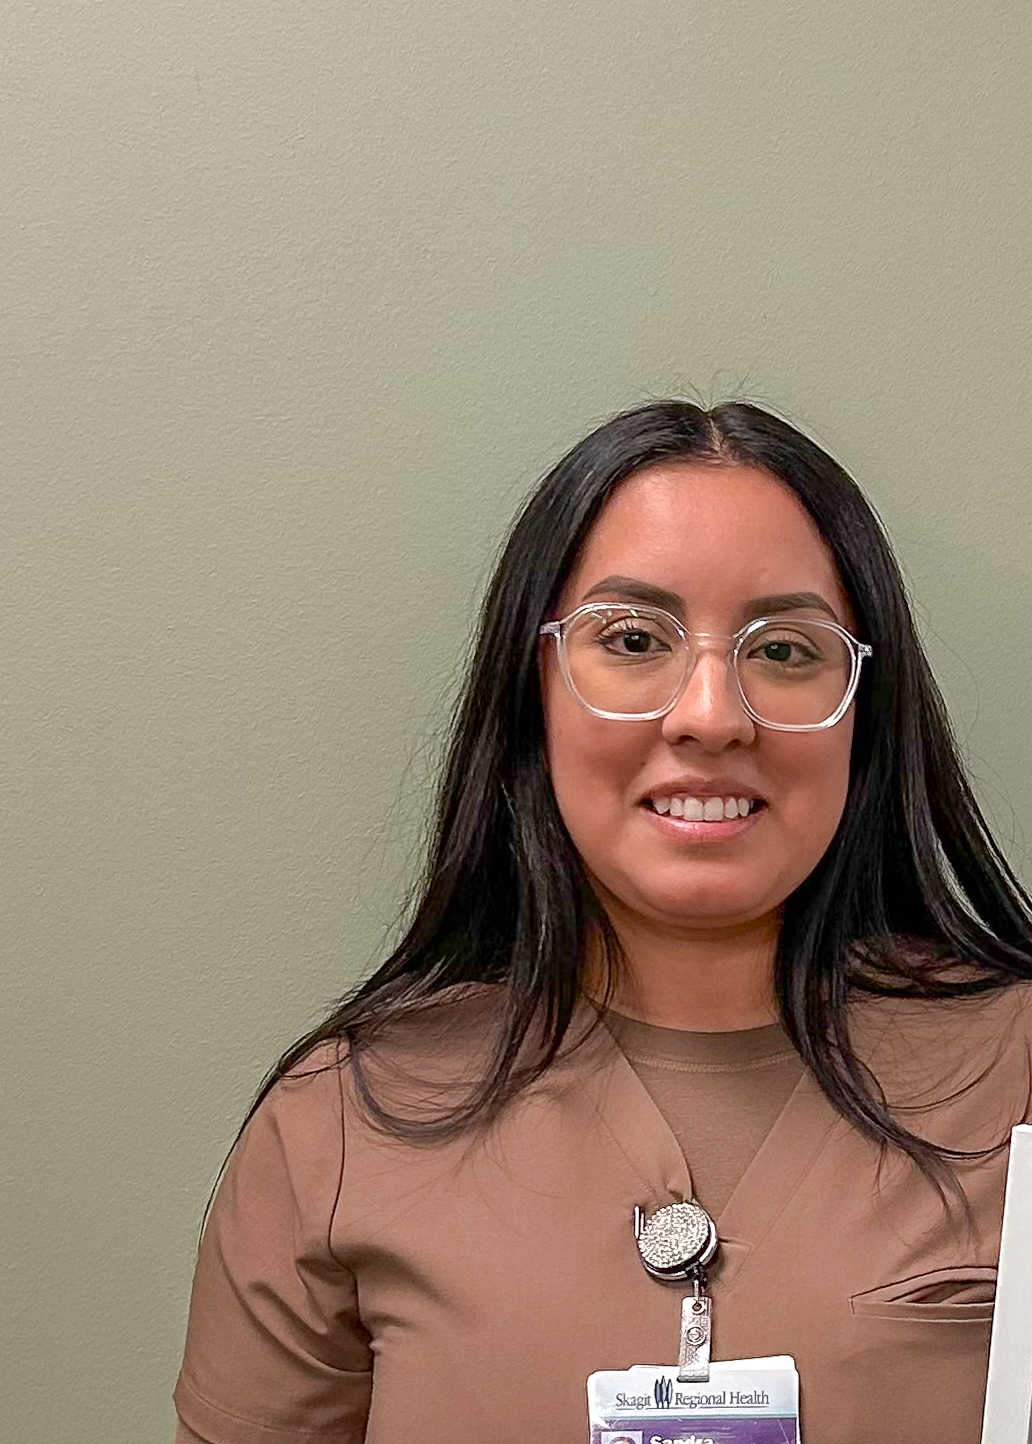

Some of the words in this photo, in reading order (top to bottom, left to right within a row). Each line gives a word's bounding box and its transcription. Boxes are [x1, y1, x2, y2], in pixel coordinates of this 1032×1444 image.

[615, 1392, 651, 1409] Skagit
[675, 1391, 726, 1408] Regional
[729, 1390, 770, 1405] Health
